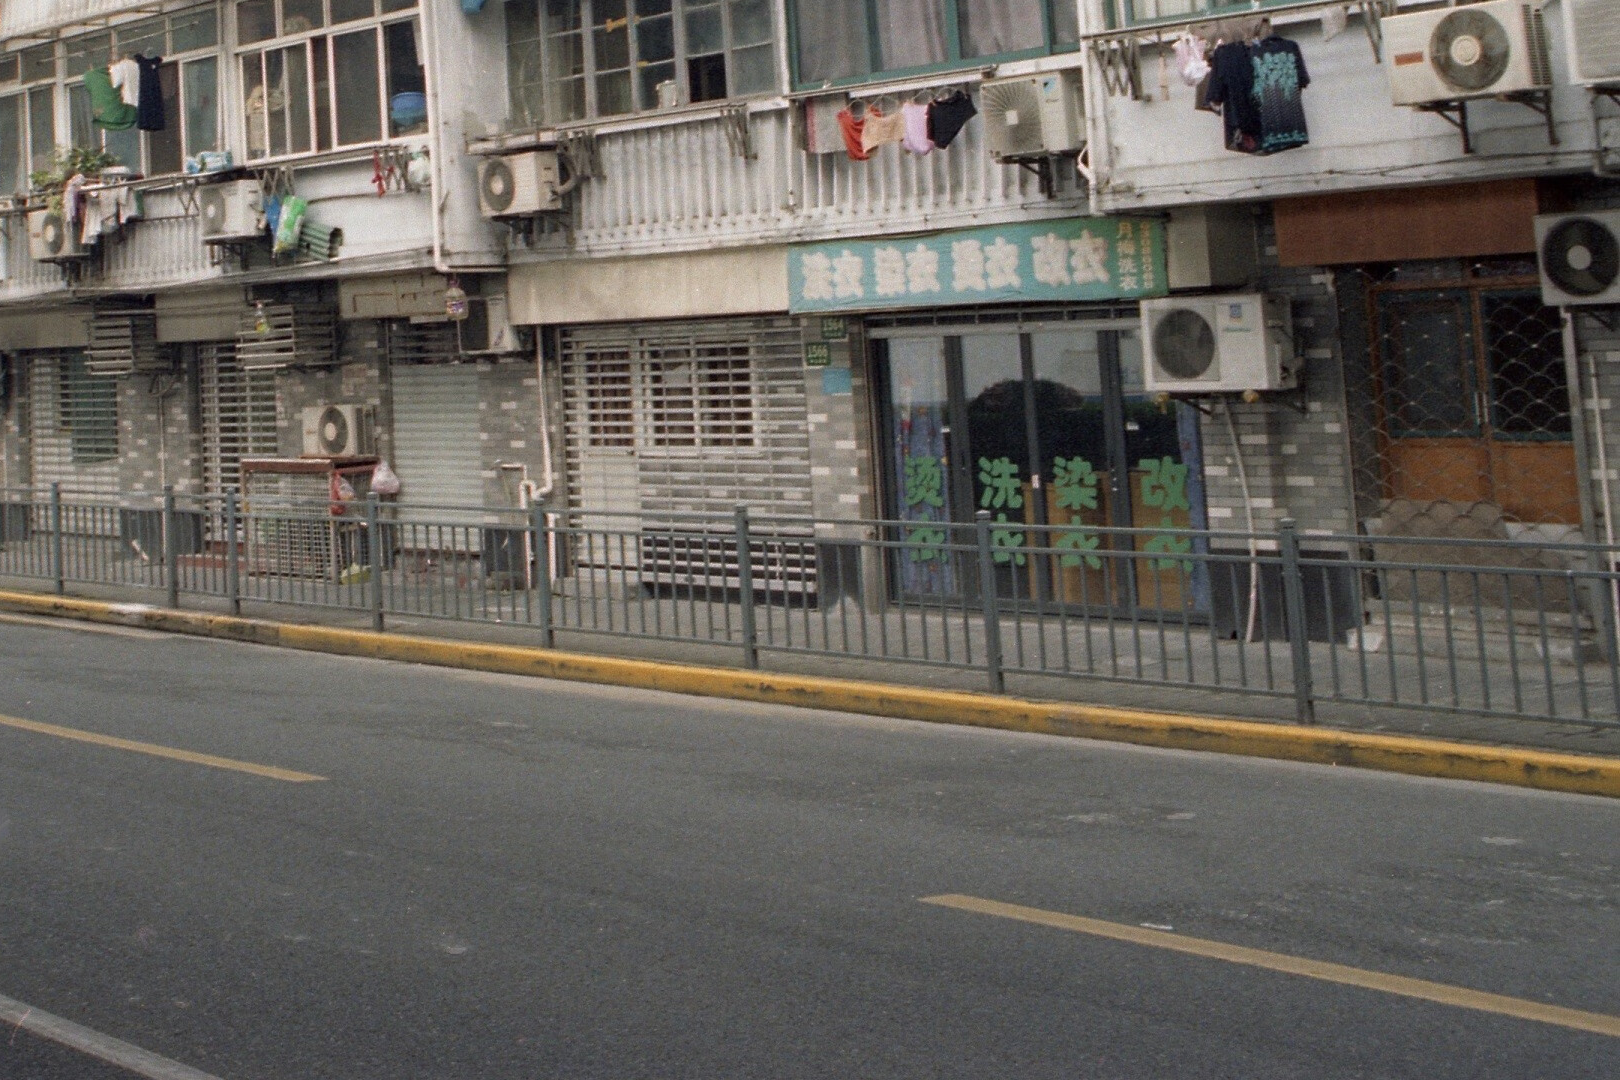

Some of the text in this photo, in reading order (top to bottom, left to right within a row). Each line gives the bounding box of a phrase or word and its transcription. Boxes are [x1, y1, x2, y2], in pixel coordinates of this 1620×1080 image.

[979, 456, 1027, 565] 洗衣
[1052, 456, 1101, 570] 染衣
[1138, 456, 1194, 573] 改衣
